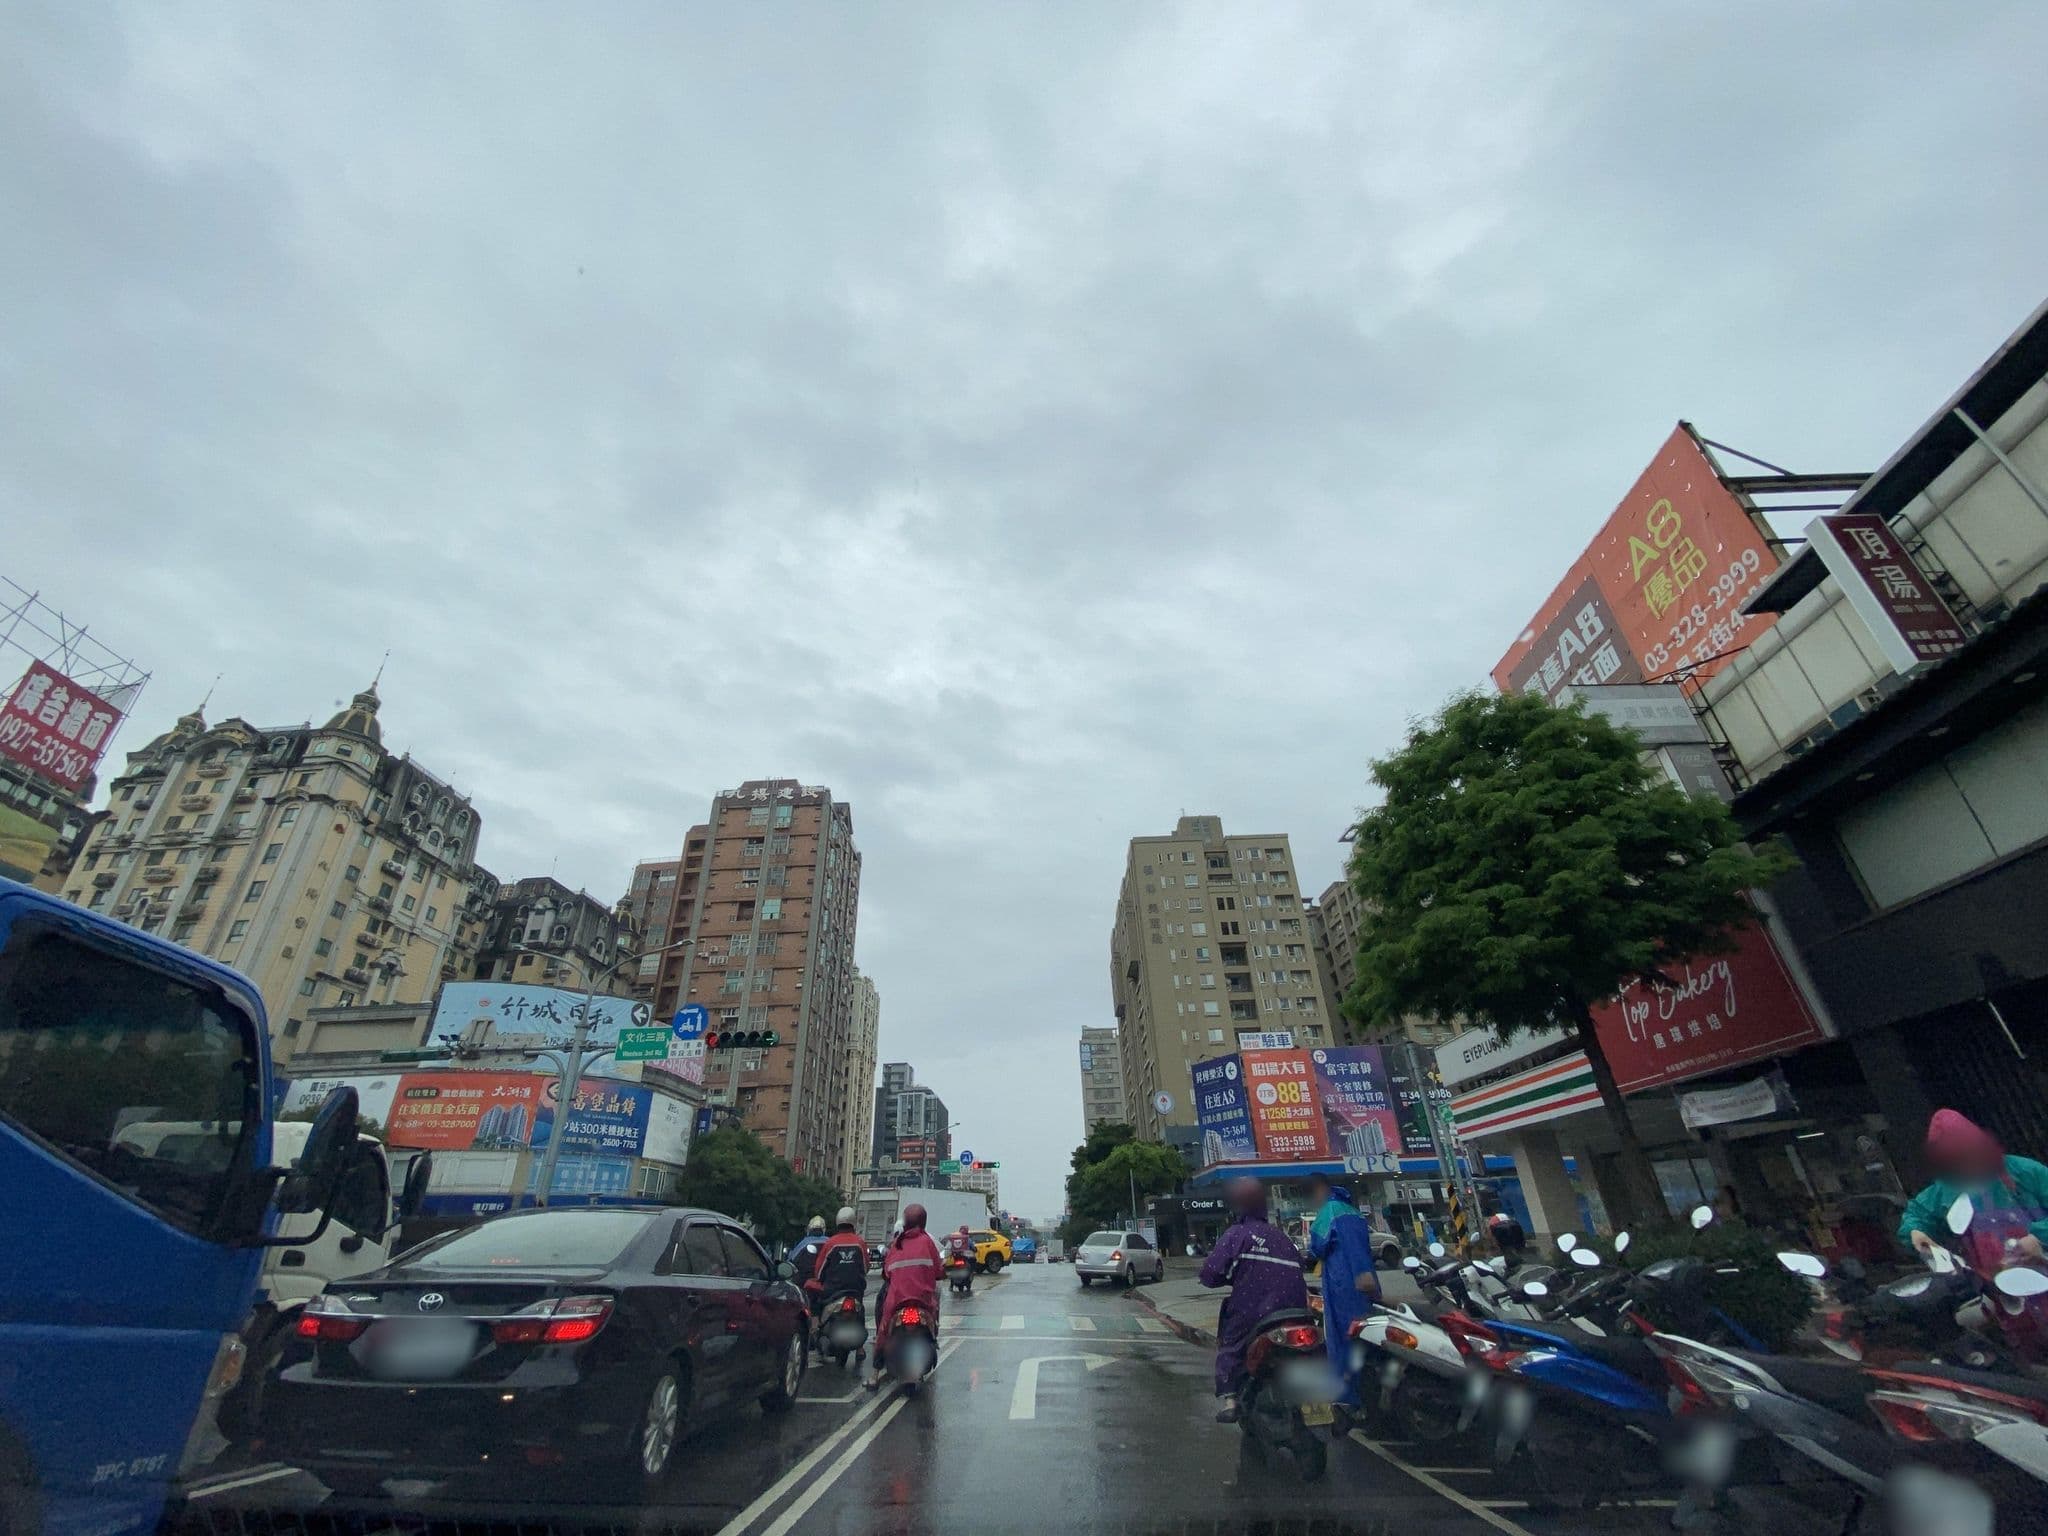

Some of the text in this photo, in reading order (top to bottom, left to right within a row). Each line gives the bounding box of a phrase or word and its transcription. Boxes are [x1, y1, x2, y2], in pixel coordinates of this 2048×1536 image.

[1627, 497, 1682, 583] A8
[1642, 536, 1709, 618] 優品
[1644, 548, 1760, 674] 03-328-2999
[625, 1031, 667, 1043] 文化三路
[1261, 1034, 1291, 1047] 驗車
[1205, 1088, 1236, 1110] 住近A8
[1276, 1081, 1301, 1104] 88
[1349, 1154, 1396, 1172] CPC
[1191, 1199, 1214, 1210] Order
